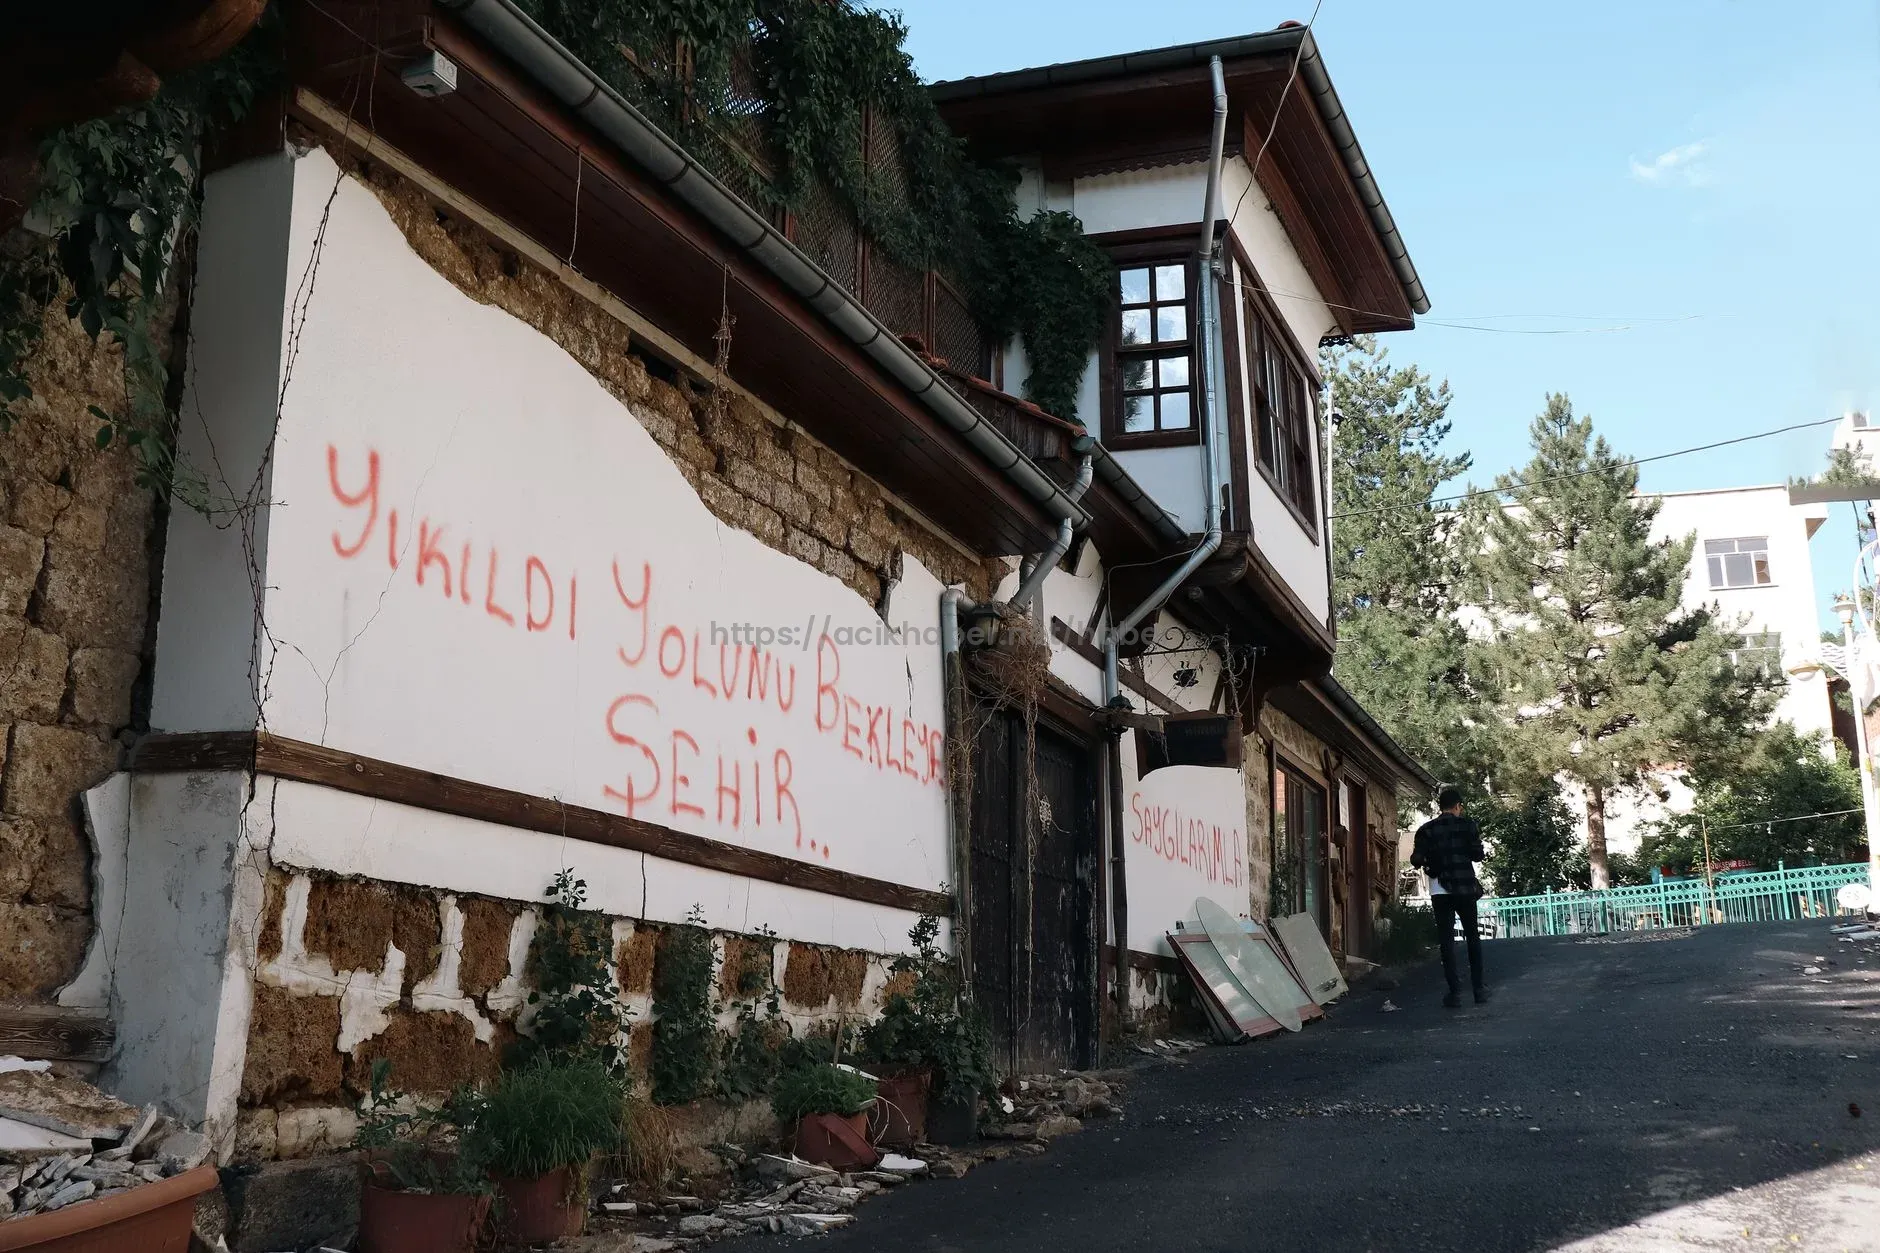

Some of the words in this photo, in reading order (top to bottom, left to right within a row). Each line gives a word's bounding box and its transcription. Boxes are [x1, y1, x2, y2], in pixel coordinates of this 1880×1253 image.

[325, 442, 578, 641] YIKILDI
[611, 554, 797, 713] YOLUNU
[1131, 791, 1243, 889] SAYGILARIMLA
